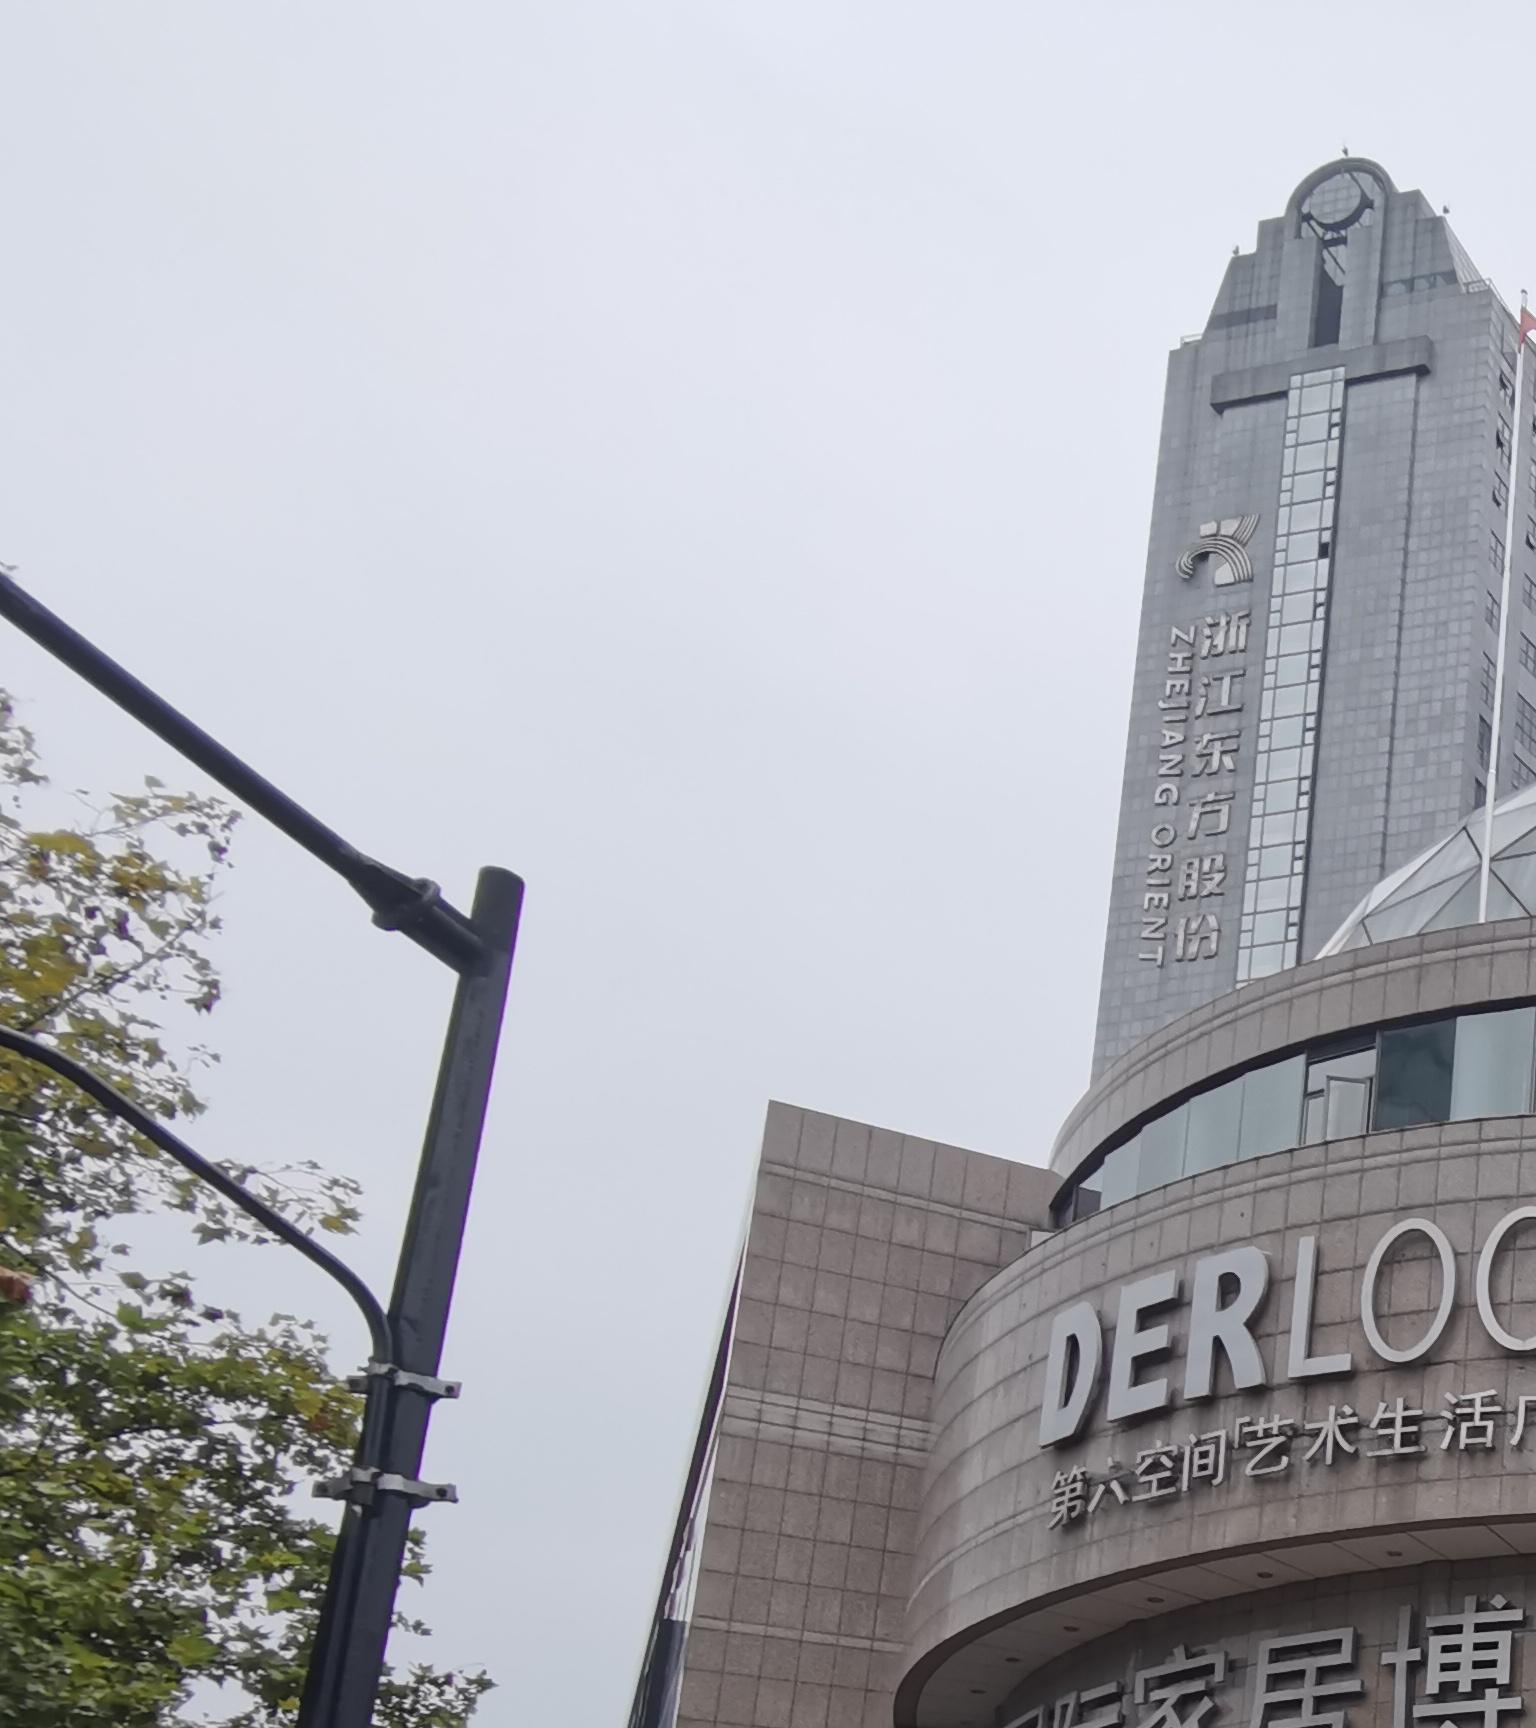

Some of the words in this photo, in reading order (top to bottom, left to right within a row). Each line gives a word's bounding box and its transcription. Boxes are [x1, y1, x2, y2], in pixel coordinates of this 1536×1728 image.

[1154, 625, 1195, 807] ZHEJIANG
[1173, 609, 1252, 963] 浙江东方股份
[1137, 823, 1177, 968] ORIENT
